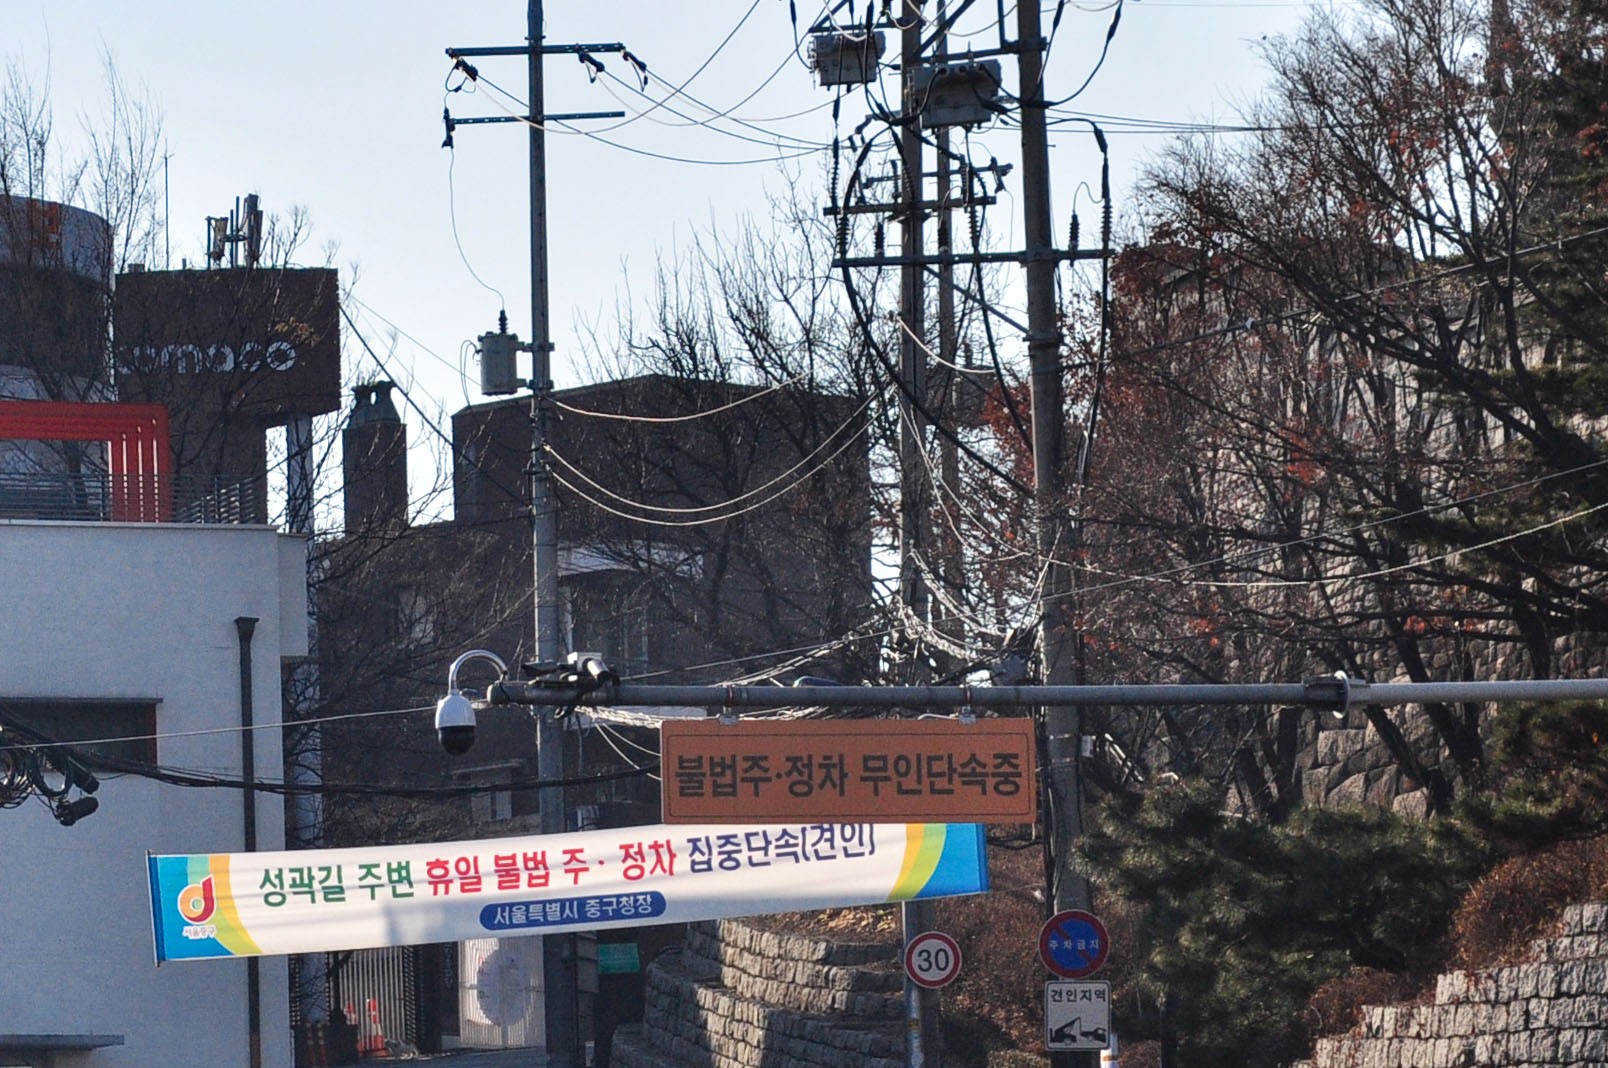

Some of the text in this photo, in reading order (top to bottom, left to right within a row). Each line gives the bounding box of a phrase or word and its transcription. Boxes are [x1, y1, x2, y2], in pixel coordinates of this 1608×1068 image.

[675, 752, 1023, 797] 불법주·정차 무인단속중
[258, 862, 347, 908] 성곽길
[358, 859, 416, 900] 주변
[426, 855, 482, 896] 휴일
[493, 849, 551, 891] 불법
[619, 838, 678, 881] 정차
[686, 824, 877, 874] 집중단속(견인)
[493, 894, 653, 926] 서울특별시 중구청장
[1048, 937, 1100, 950] 주차금지
[918, 947, 949, 972] 30
[1051, 987, 1107, 1003] 견인지역
